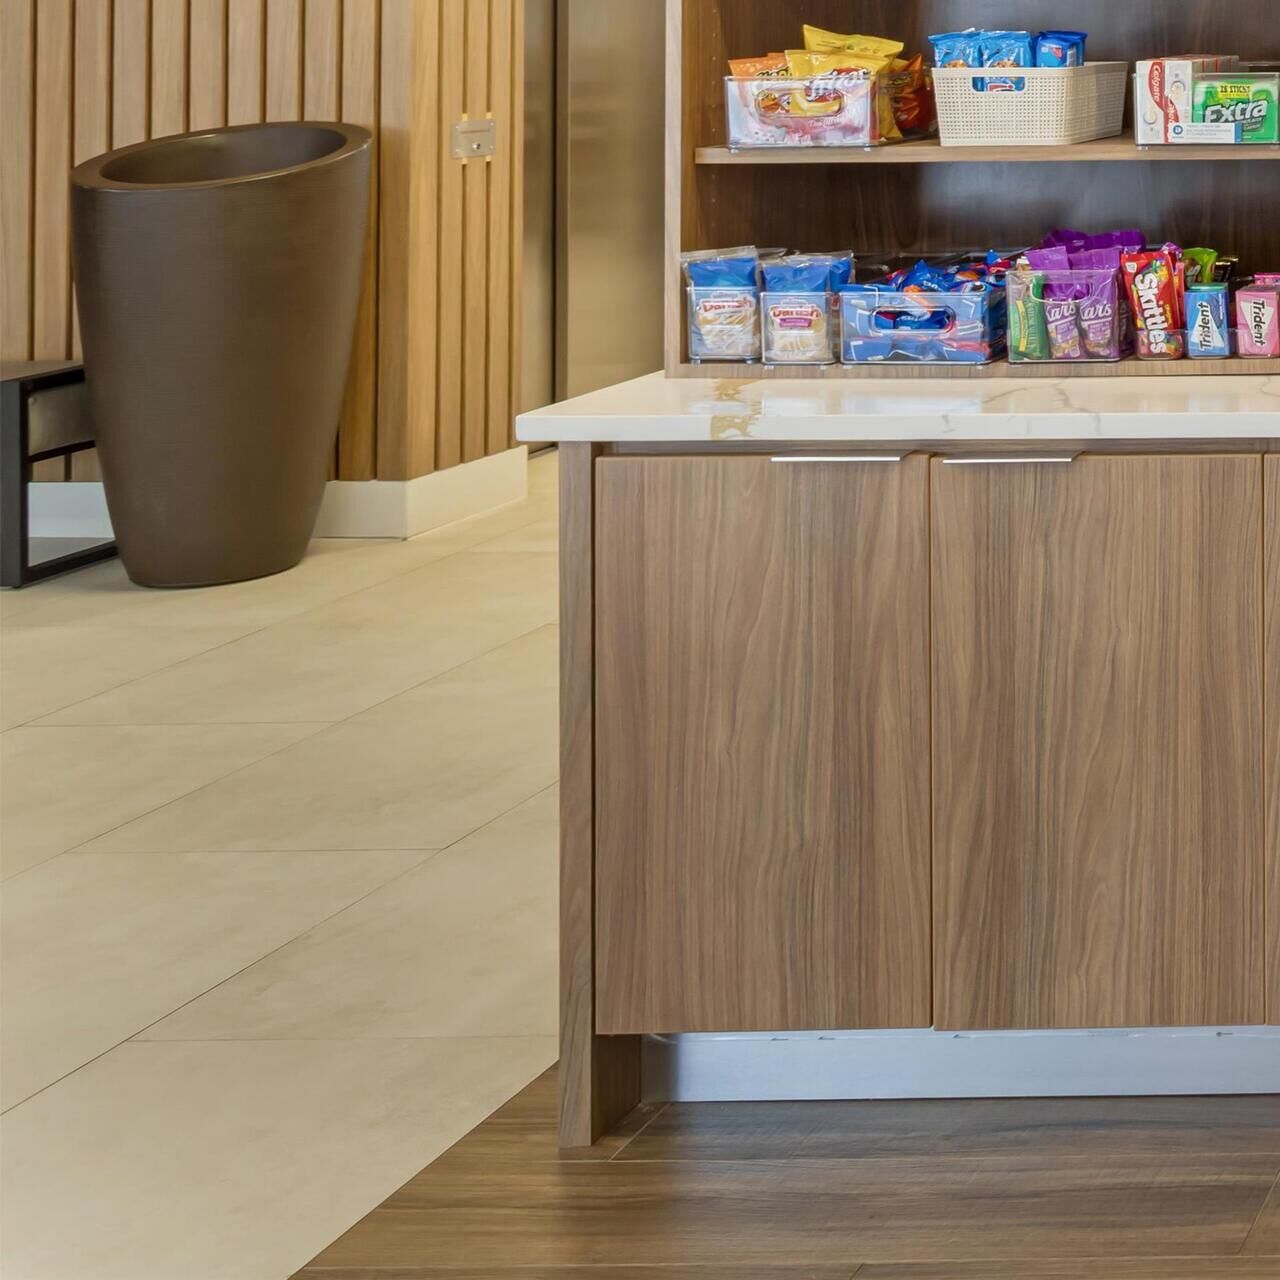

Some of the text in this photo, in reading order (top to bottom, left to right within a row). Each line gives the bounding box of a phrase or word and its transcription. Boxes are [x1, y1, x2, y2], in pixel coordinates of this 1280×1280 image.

[1151, 65, 1161, 103] Colgate
[1205, 99, 1269, 124] Extra
[1135, 272, 1168, 354] Skittles
[1199, 302, 1212, 350] Trident
[1252, 300, 1266, 347] Trident
